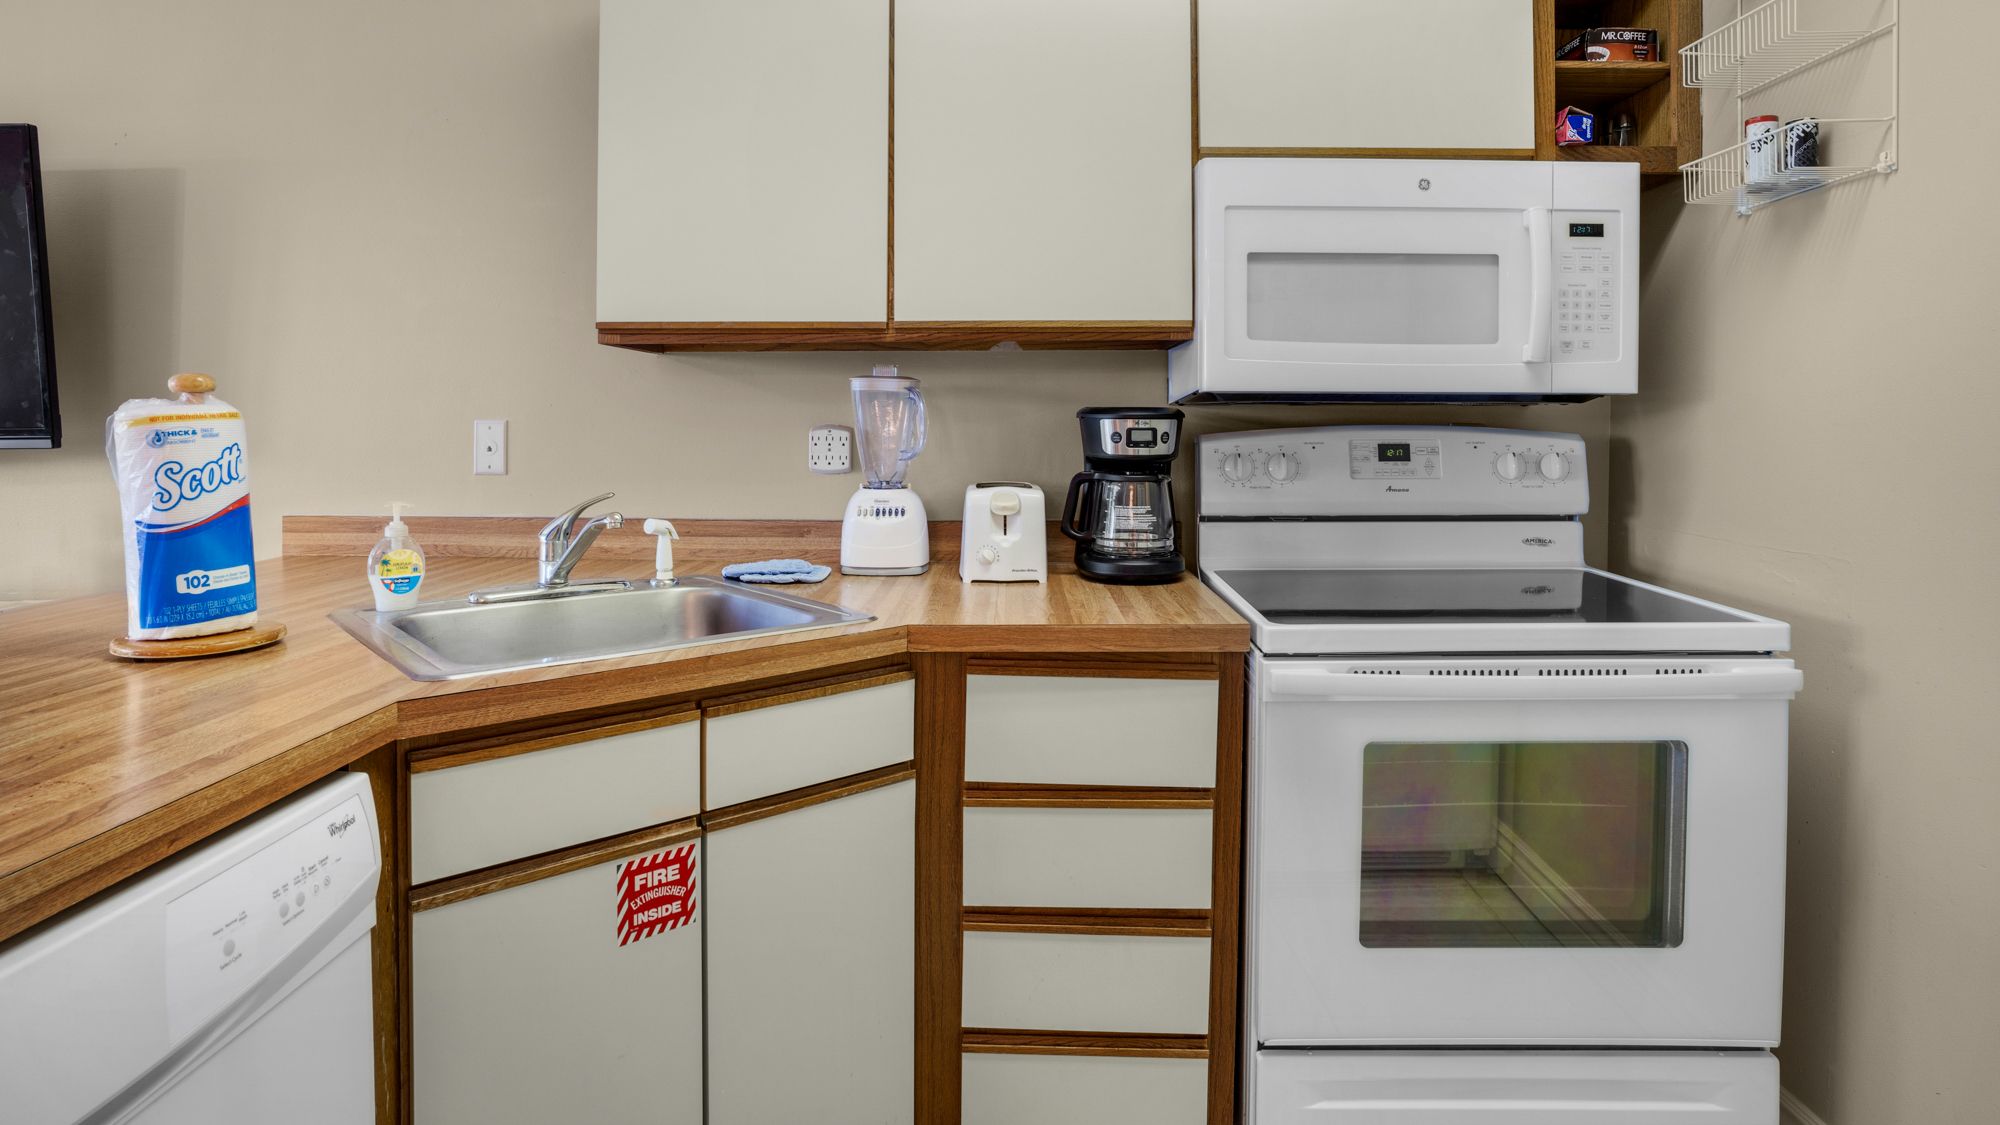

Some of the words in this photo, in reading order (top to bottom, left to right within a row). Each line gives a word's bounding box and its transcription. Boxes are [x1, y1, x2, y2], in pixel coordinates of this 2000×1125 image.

[152, 442, 241, 512] Scott
[183, 574, 210, 590] 102
[634, 863, 680, 892] FIRE
[630, 885, 687, 911] EXTINGUISHER
[633, 900, 682, 926] INSIDE
